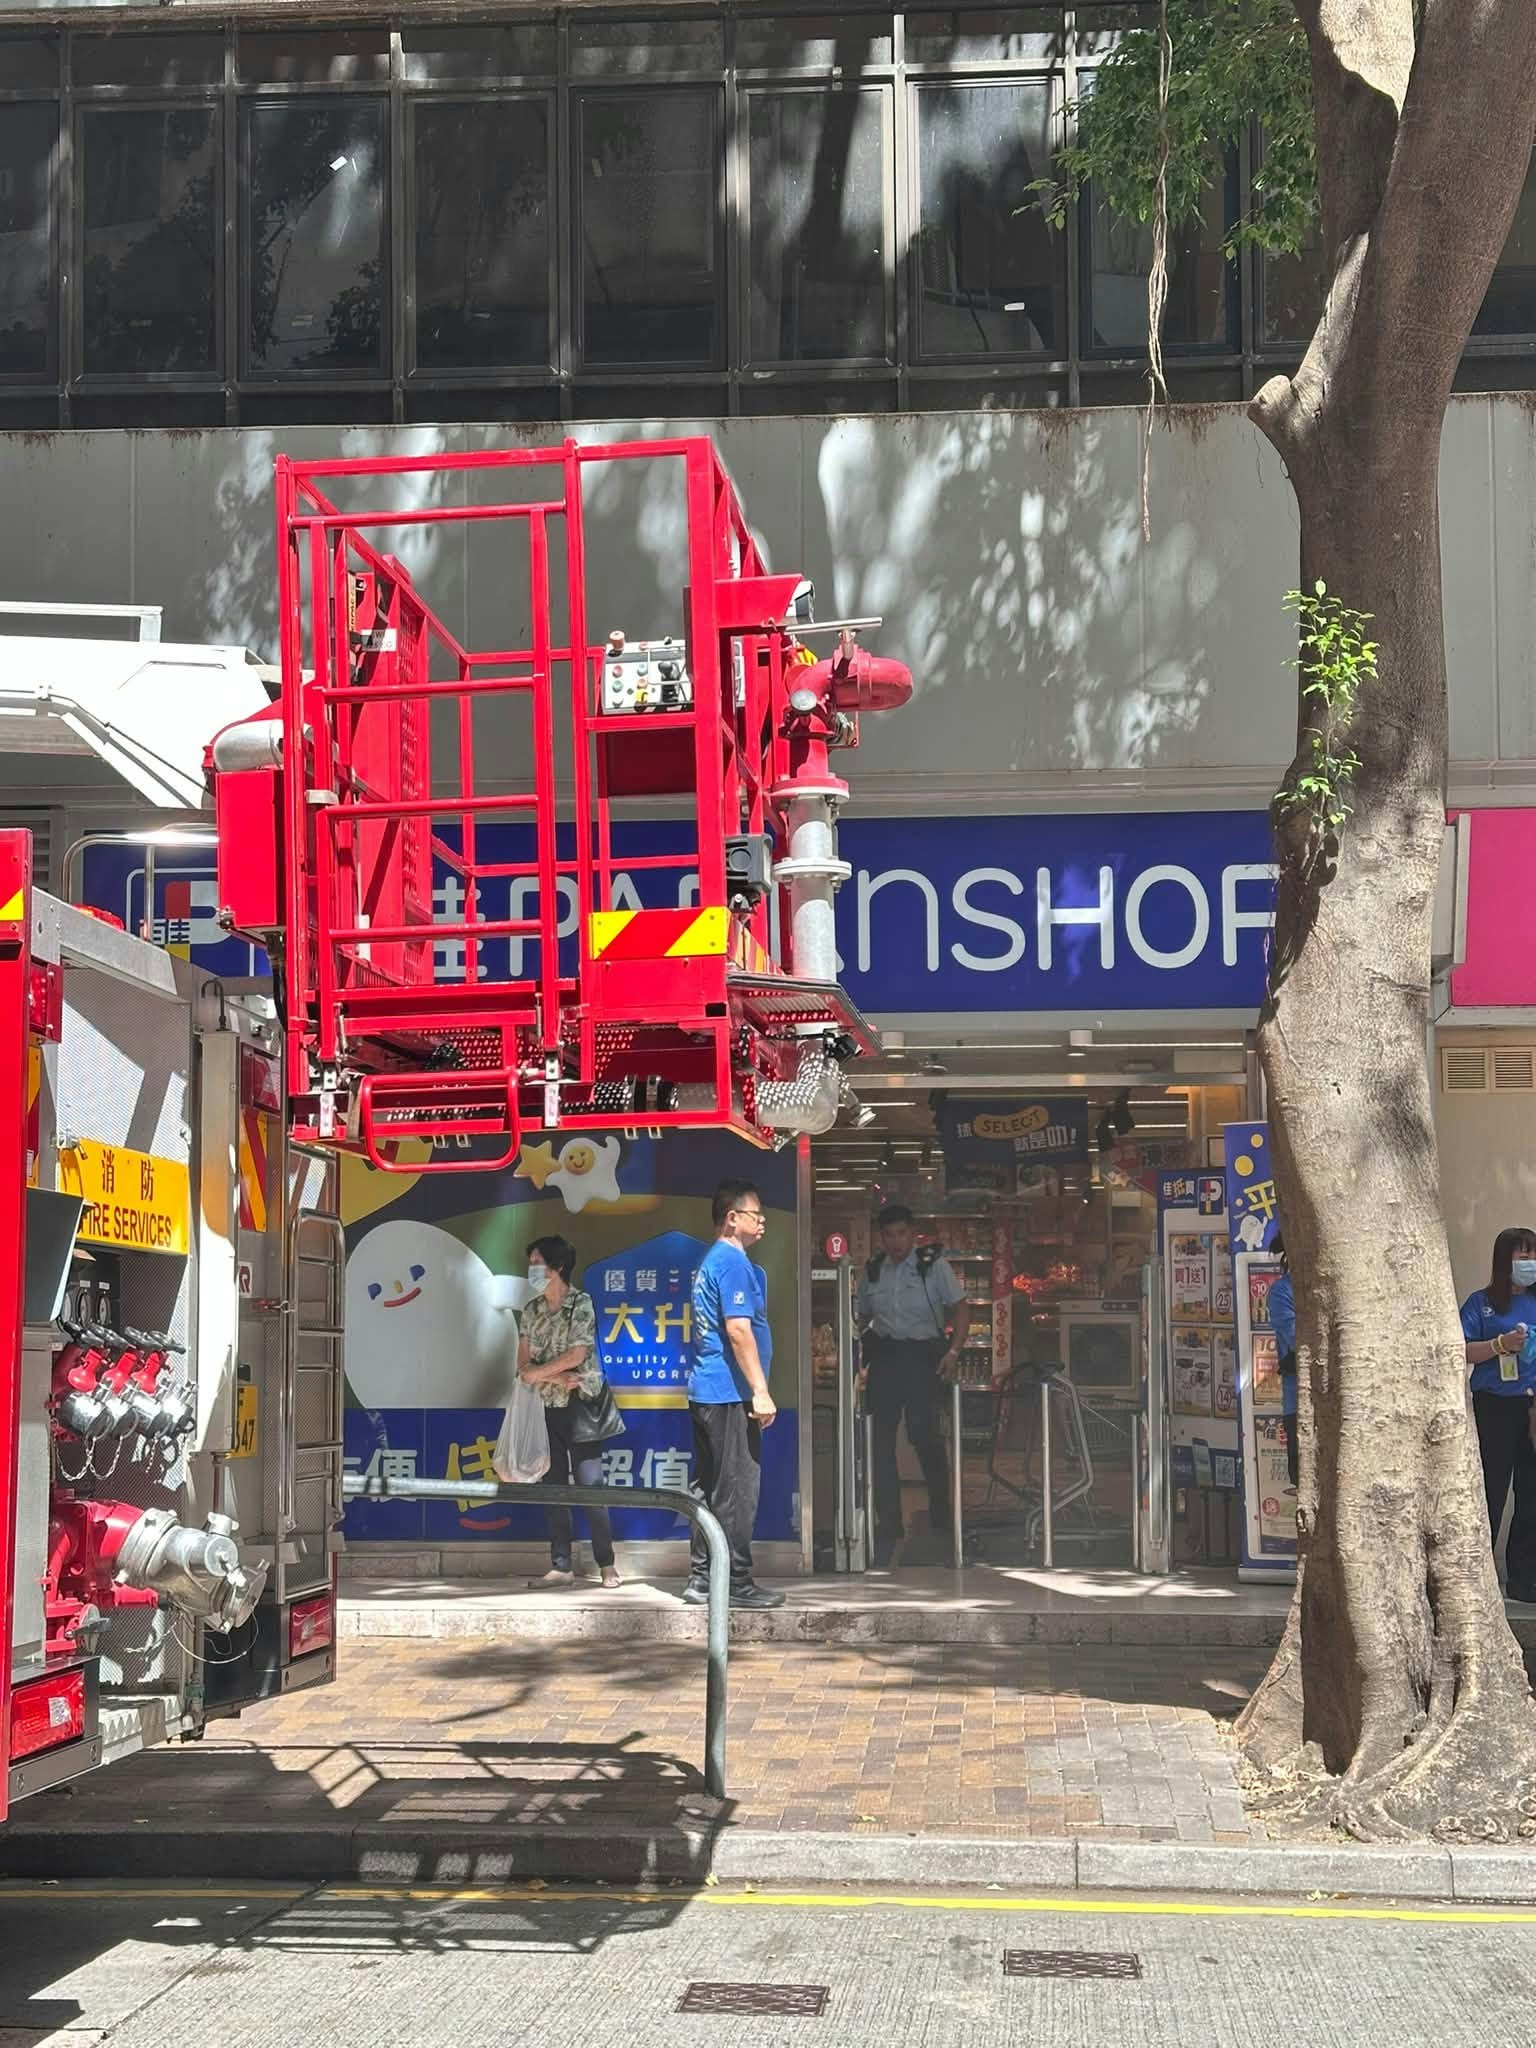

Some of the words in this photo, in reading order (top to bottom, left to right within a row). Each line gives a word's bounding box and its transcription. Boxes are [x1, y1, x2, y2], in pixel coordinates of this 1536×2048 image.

[983, 1110, 1041, 1133] SELECT
[101, 1149, 154, 1202] 消防
[113, 1206, 172, 1248] SERVICES
[603, 1354, 668, 1365] Quality
